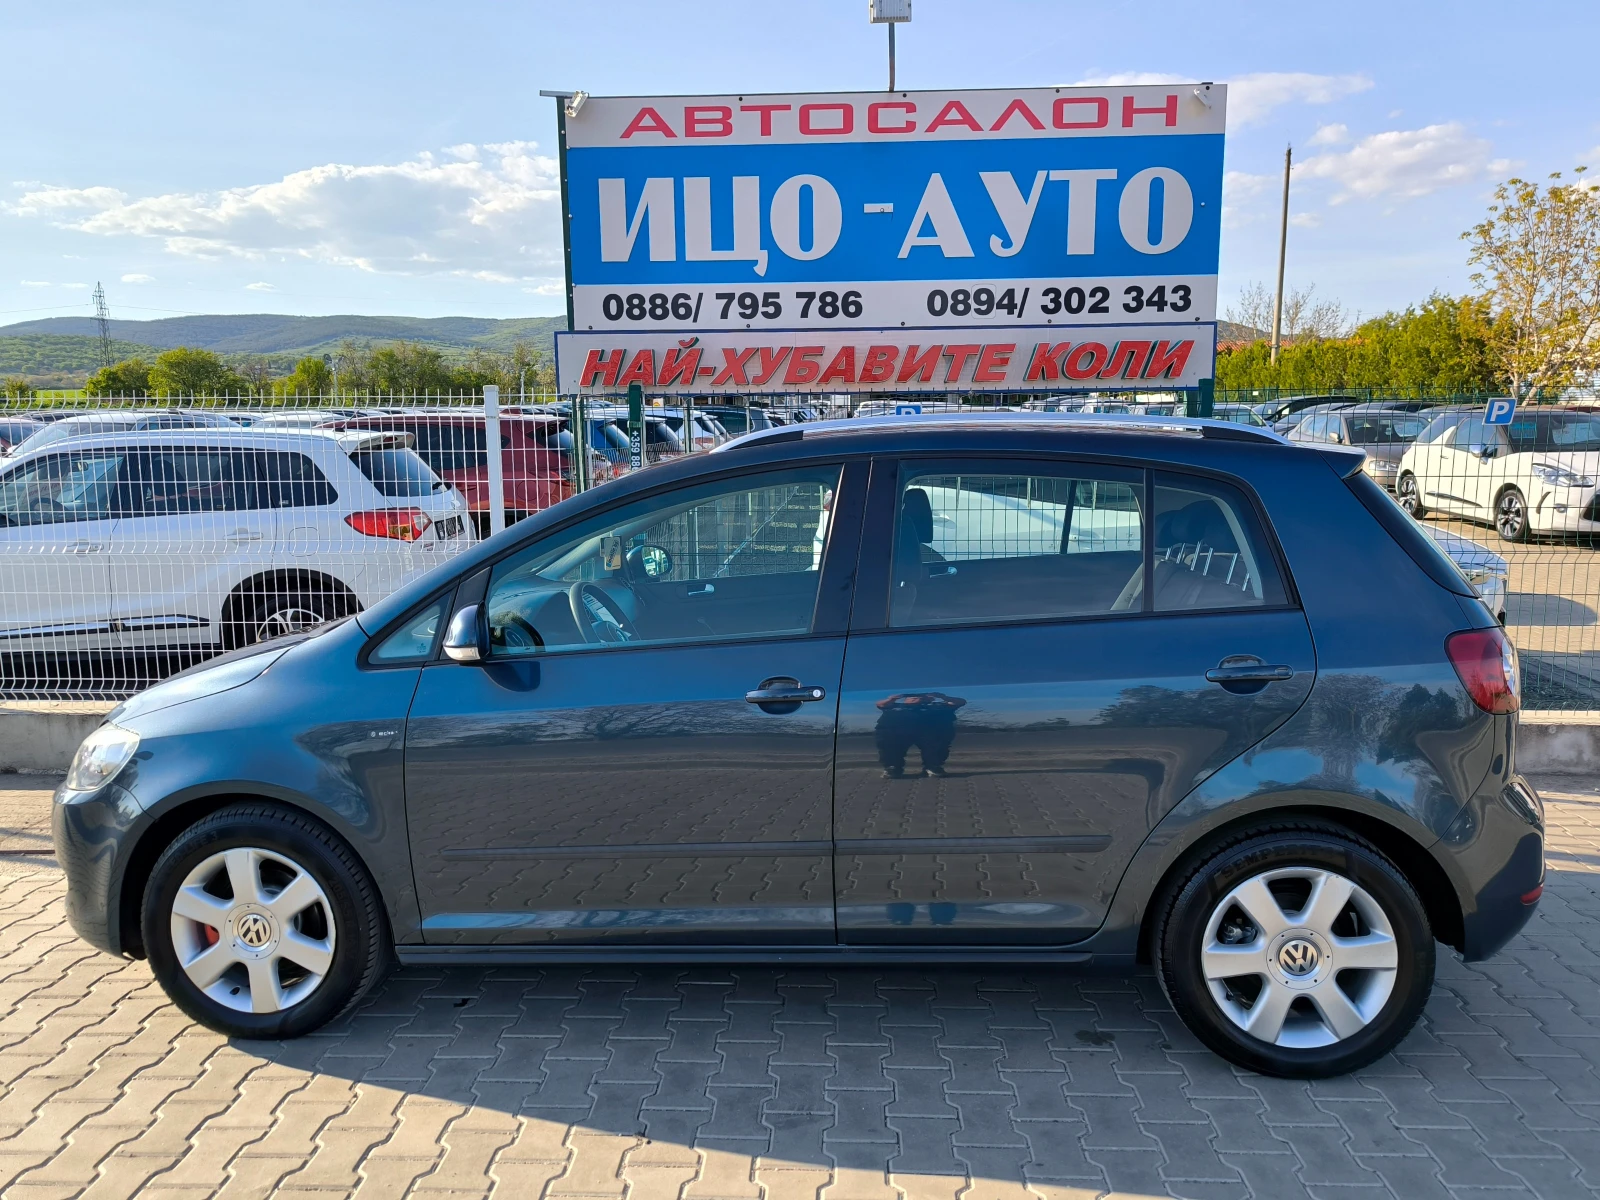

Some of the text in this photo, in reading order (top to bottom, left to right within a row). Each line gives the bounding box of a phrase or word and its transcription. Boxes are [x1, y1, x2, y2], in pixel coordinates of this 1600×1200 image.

[619, 94, 1178, 139] АВТОСАЛОН
[602, 290, 863, 323] 0886/ 795 786
[926, 284, 1192, 319] 0894/ 302 343
[579, 336, 1195, 387] НАЙ-ХУБАВИТЕ КОЛИ
[1489, 401, 1510, 422] P
